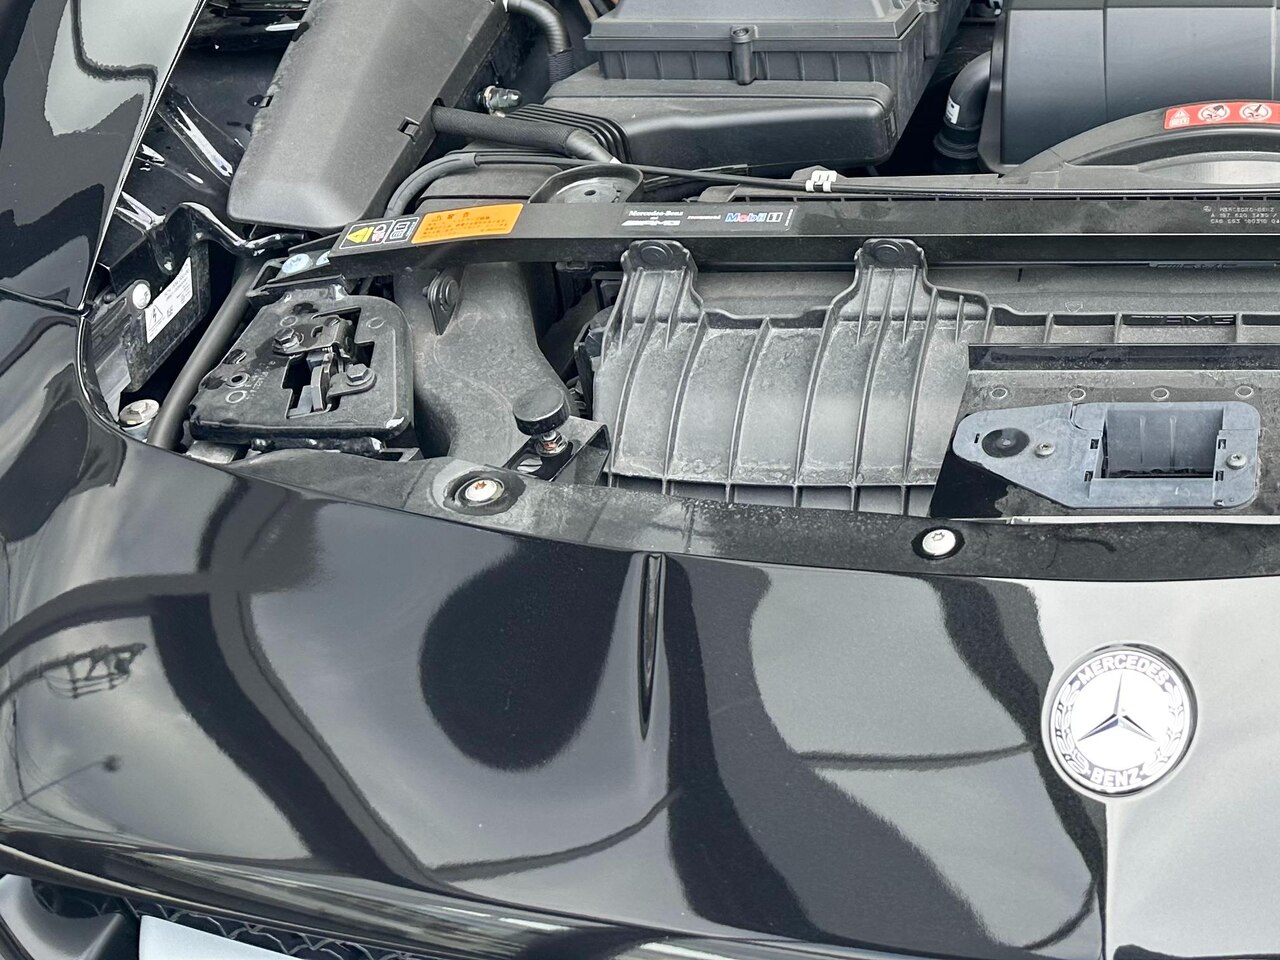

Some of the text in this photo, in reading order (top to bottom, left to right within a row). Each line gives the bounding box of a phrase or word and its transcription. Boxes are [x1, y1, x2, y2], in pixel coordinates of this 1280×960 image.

[725, 212, 767, 223] Mobil
[1077, 654, 1169, 686] MERCEDES
[1090, 767, 1143, 787] BENZ
